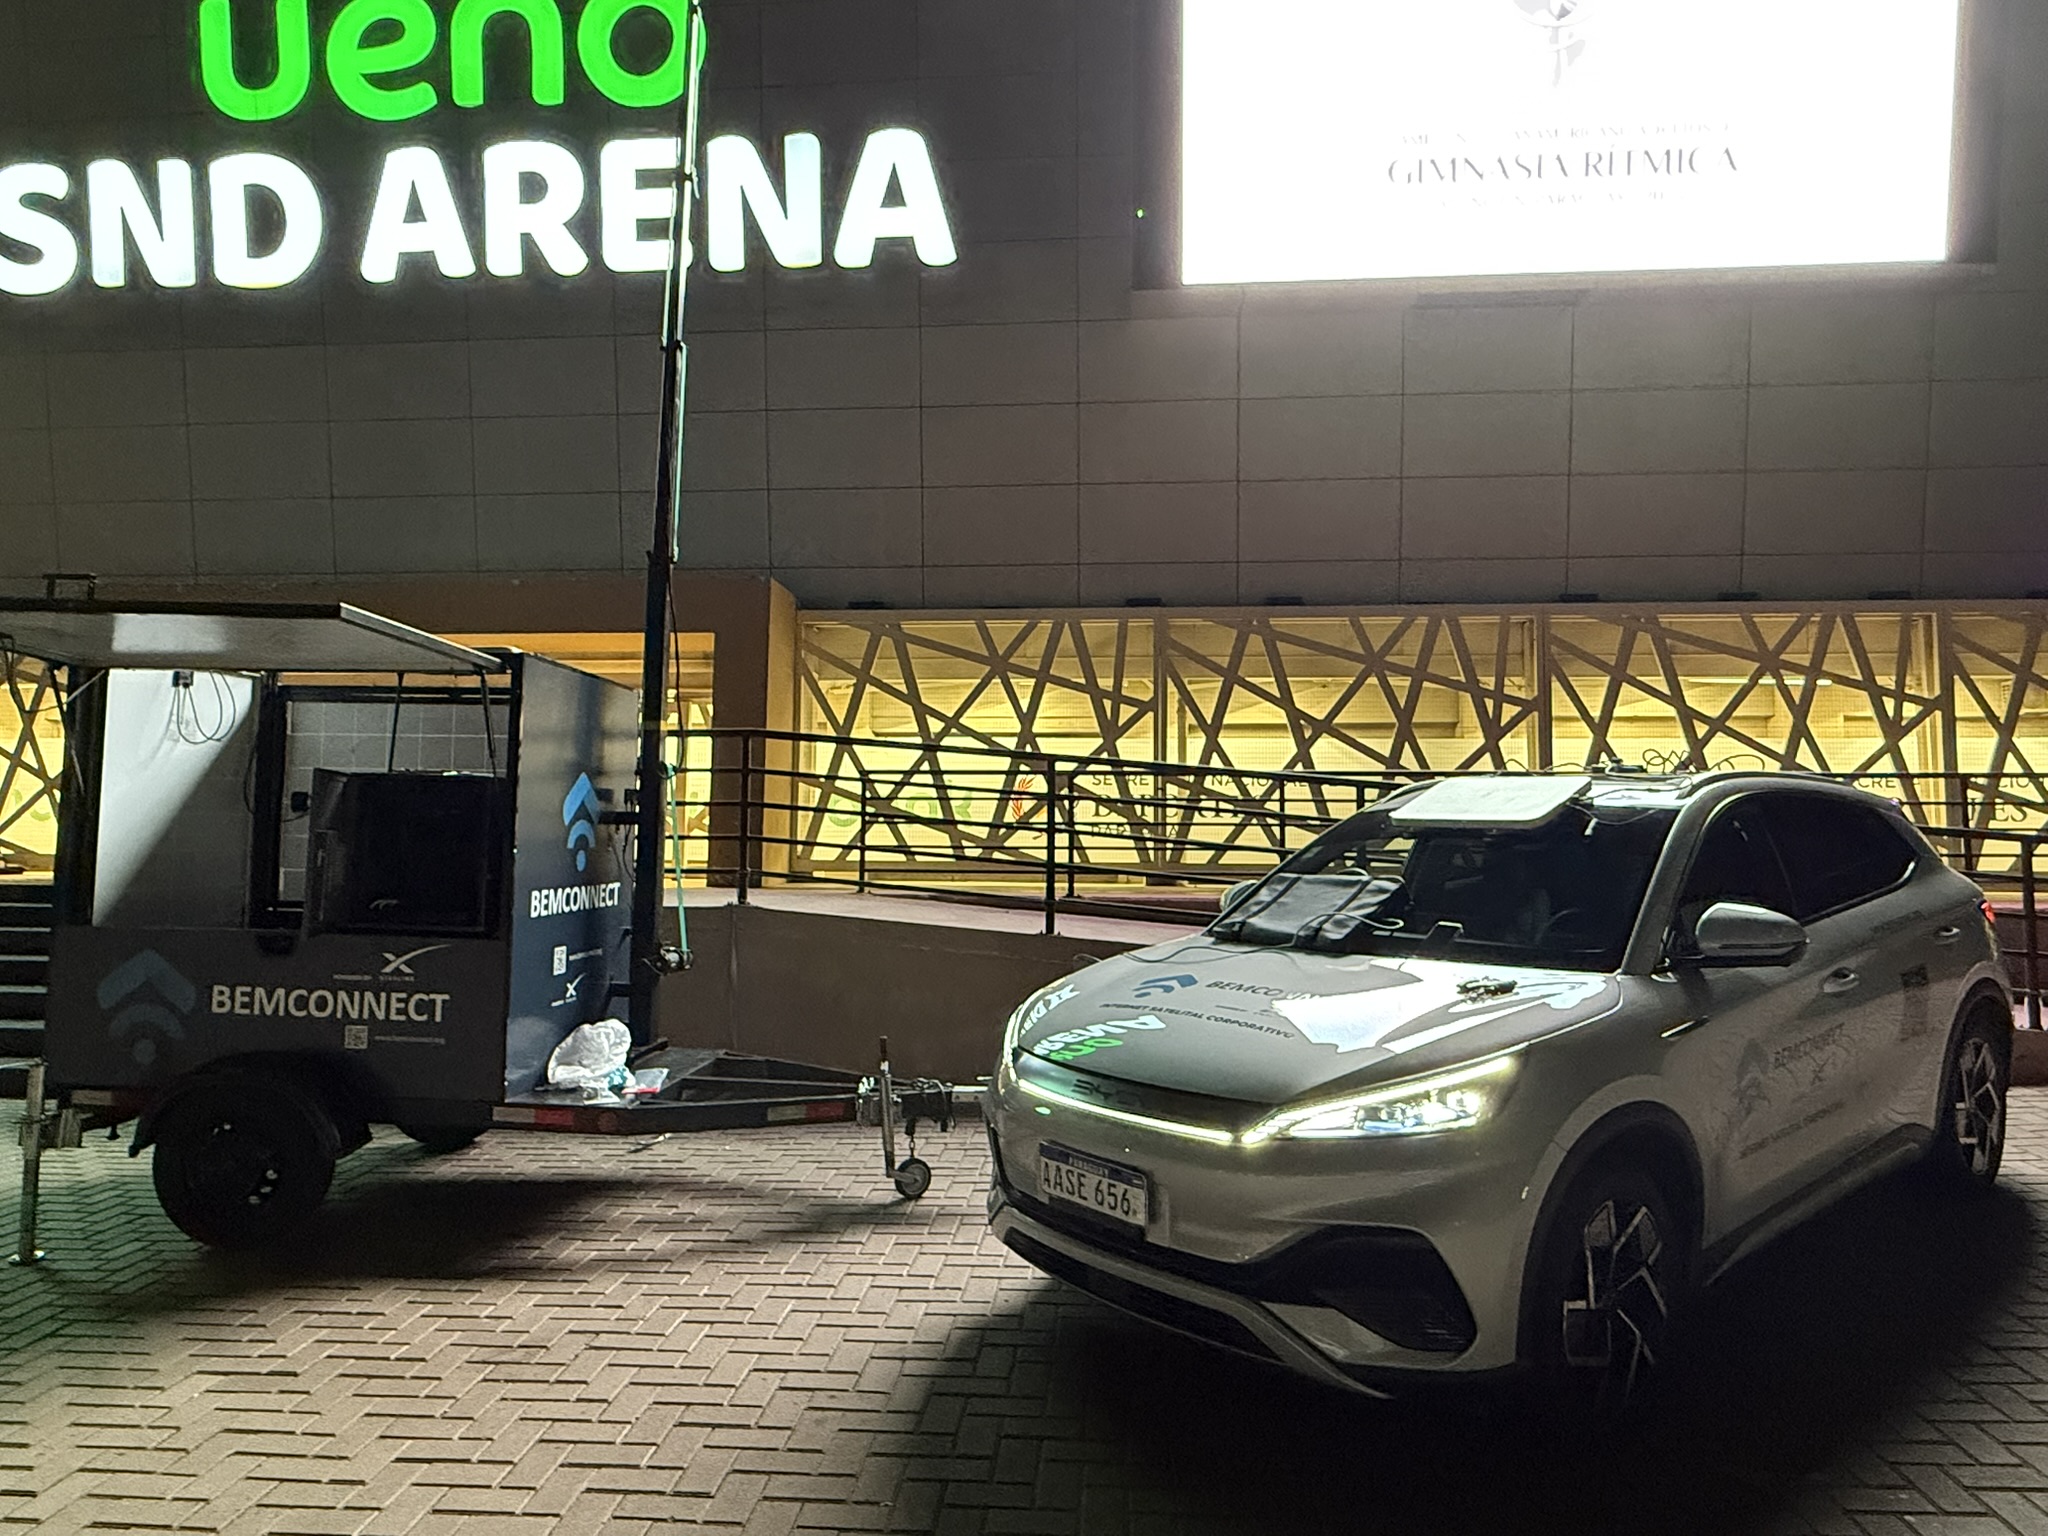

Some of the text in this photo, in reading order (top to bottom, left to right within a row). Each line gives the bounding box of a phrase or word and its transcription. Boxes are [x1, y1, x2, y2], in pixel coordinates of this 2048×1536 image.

[0, 127, 959, 297] SND ARENA
[529, 881, 622, 919] BEMCONNECT
[211, 983, 450, 1025] BEMCONNECT
[1205, 980, 1285, 997] BEMCO
[1149, 1005, 1203, 1019] SATELITAL
[1206, 1013, 1295, 1039] CORPORATIVO
[1043, 1161, 1131, 1217] AASE 656
